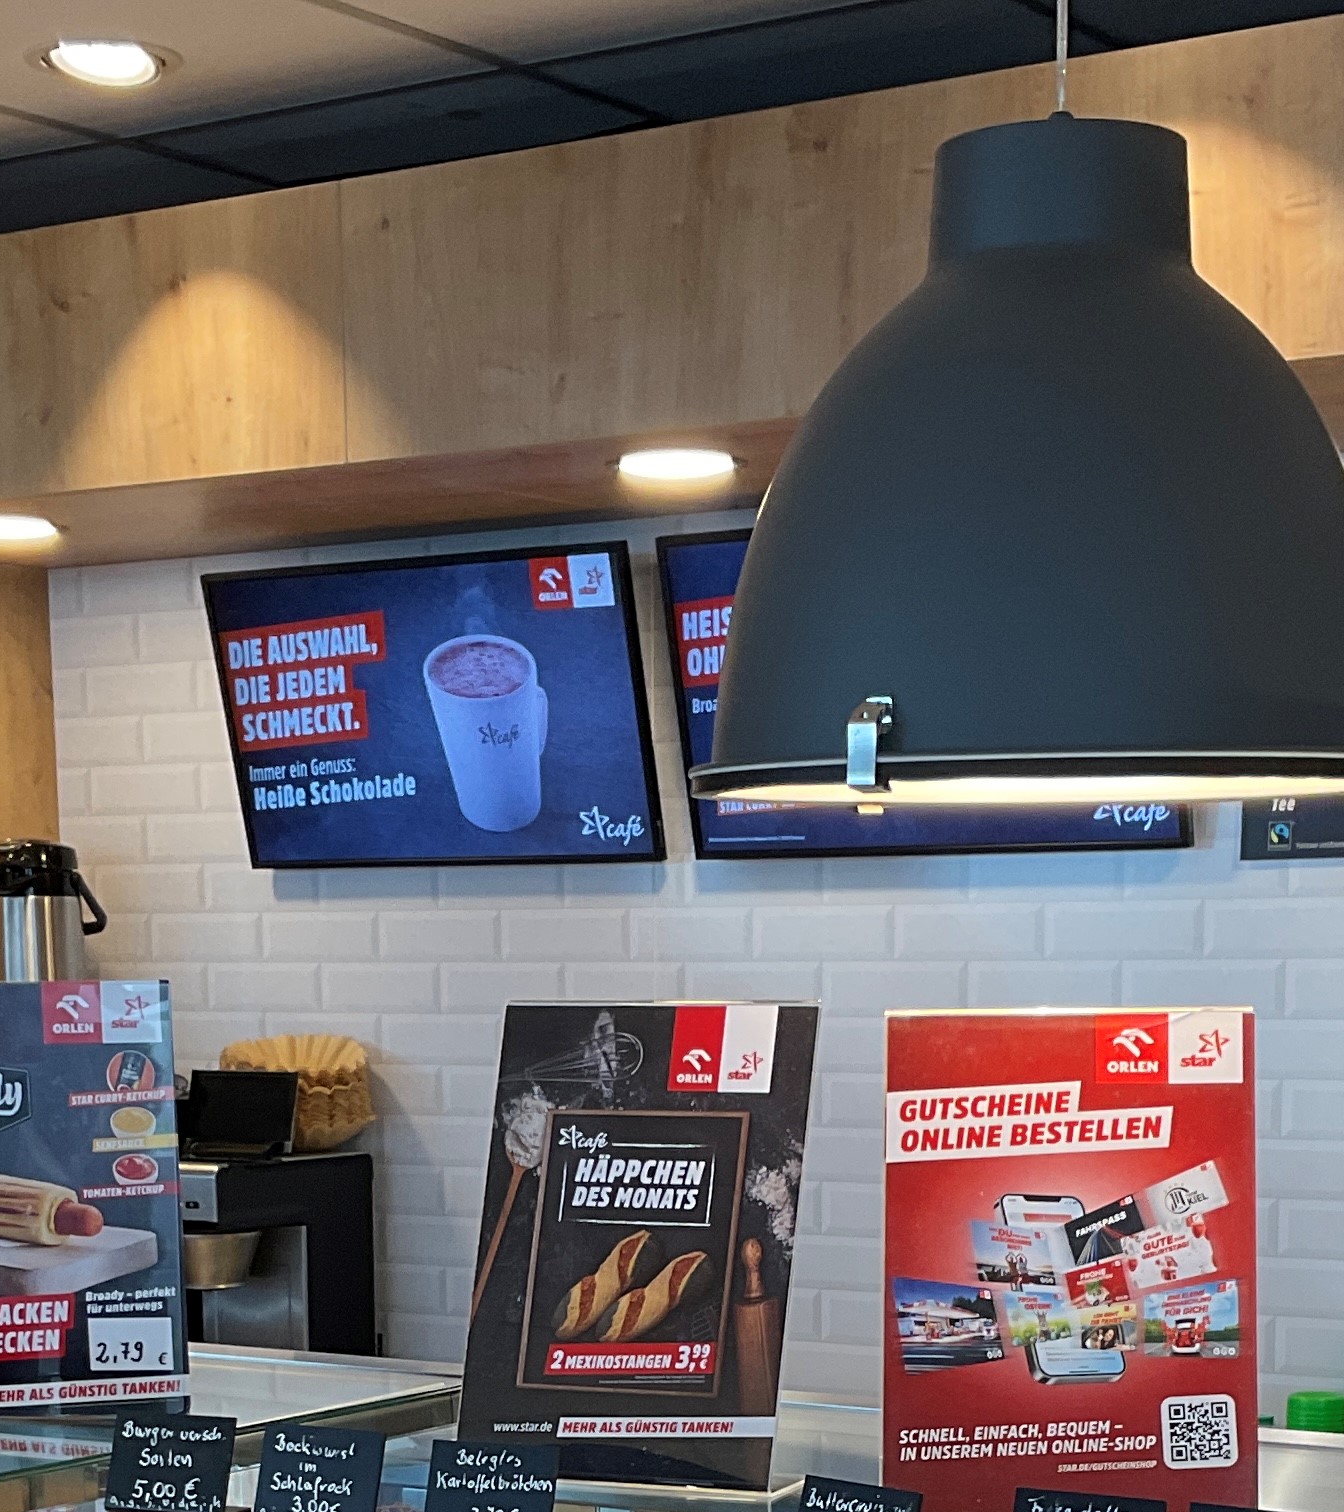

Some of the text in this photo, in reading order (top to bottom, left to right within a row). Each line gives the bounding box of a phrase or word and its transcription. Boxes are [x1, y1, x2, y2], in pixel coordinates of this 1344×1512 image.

[228, 624, 377, 669] DIE AUSWAHL,
[235, 665, 345, 705] DIE JEDEM
[242, 701, 360, 743] SCHMECKT.
[249, 756, 356, 782] Immer ein Genuss:
[254, 773, 416, 811] Heiße Schokolade
[53, 1022, 94, 1034] ORLEN
[111, 1018, 139, 1029] star
[1107, 1061, 1159, 1073] ORLEN
[1180, 1053, 1216, 1068] star
[676, 1073, 712, 1084] ORLEN
[728, 1070, 752, 1081] star
[72, 1095, 92, 1105] STAR
[899, 1091, 1070, 1122] GUTSCHEINE
[900, 1116, 1162, 1152] ONLINE BESTELLEN
[575, 1154, 705, 1185] HÄPPCHEN
[83, 1185, 164, 1198] TOMATEN-KETCHUP
[572, 1186, 697, 1210] DES MONATS
[1076, 1211, 1127, 1237] FAHRSPASS
[1143, 1236, 1174, 1252] GUTE
[86, 1287, 177, 1303] Broady perfekt
[87, 1301, 163, 1316] für unterwegs
[551, 1351, 562, 1369] 2
[564, 1355, 671, 1369] MEXIKOSTANGEN
[30, 1388, 55, 1401] ALS
[59, 1383, 117, 1399] GÜNSTIG
[121, 1381, 181, 1394] TANKEN!
[122, 1420, 174, 1446] Burger
[494, 1421, 552, 1433] www.star.de
[562, 1419, 734, 1433] MEHR ALS GÜNSTIG TANKEN!
[900, 1422, 1111, 1444] SCHNELL, EINFACH, BEQUEM
[275, 1434, 355, 1459] Bockwurst
[900, 1436, 1157, 1460] IN UNSEREM NEUEN ONLINE-SHOP
[298, 1460, 317, 1472] im
[1058, 1462, 1157, 1472] STAR.DE/GUTSCHEINSHOP
[270, 1472, 354, 1496] Schlafrock
